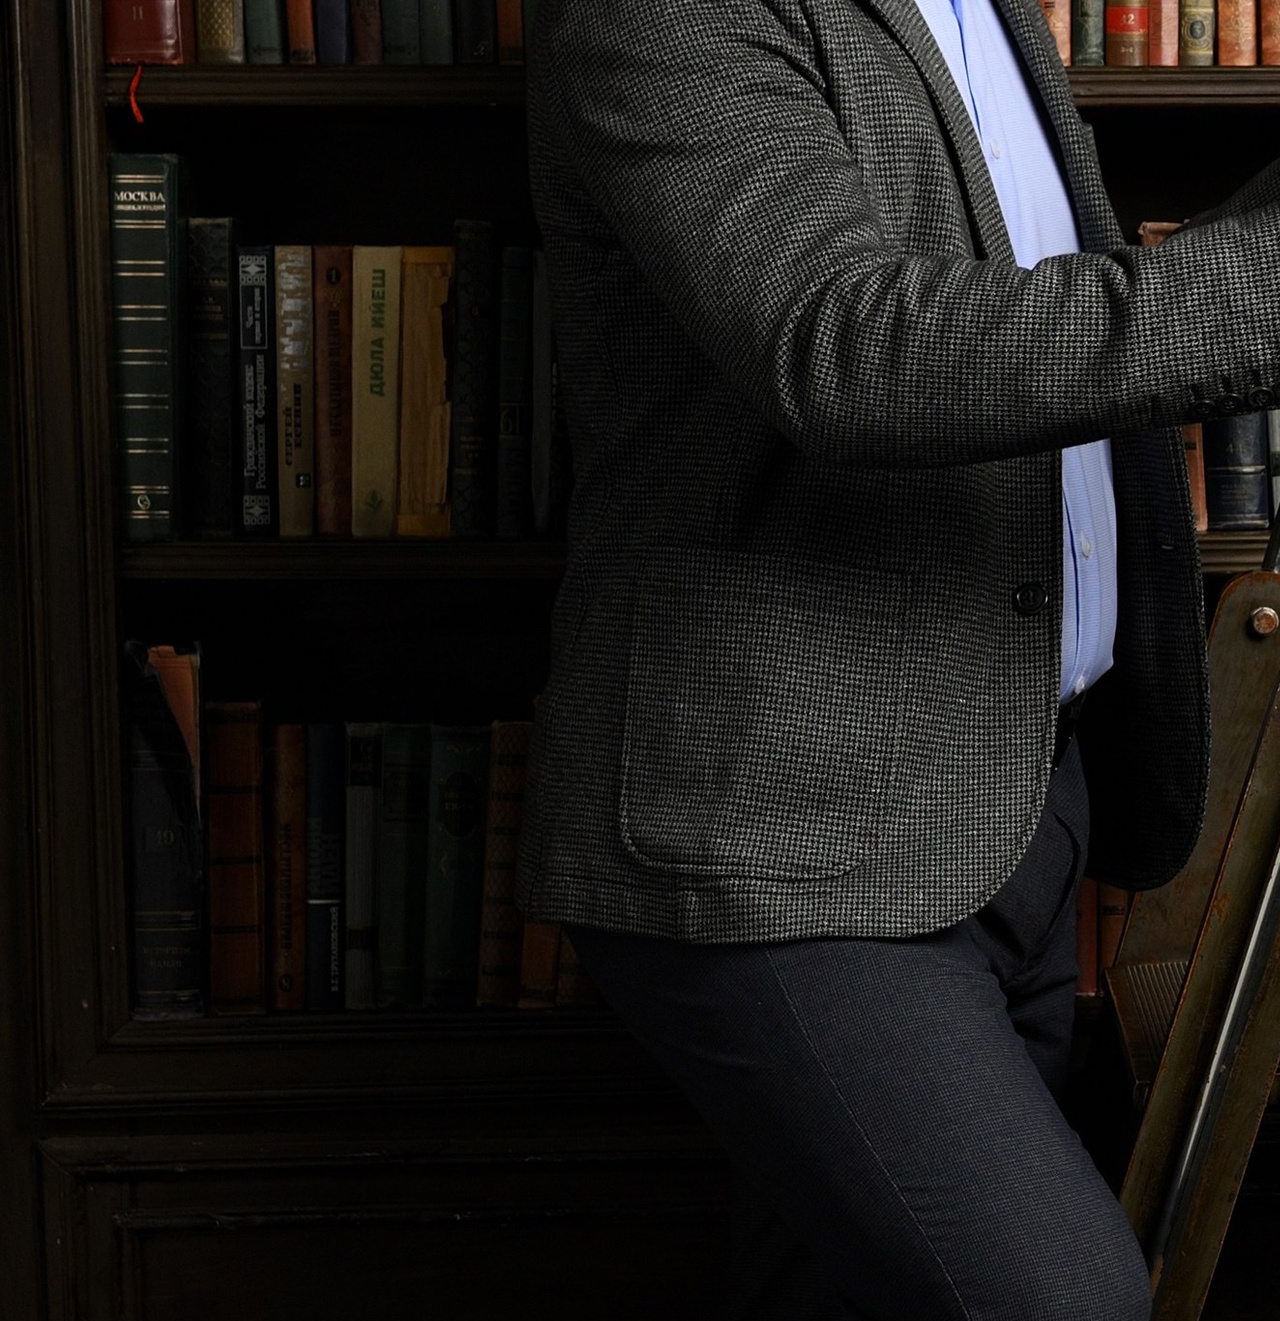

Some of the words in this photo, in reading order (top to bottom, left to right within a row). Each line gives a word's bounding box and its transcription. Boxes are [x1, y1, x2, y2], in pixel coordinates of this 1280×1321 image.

[131, 5, 144, 21] II
[113, 190, 166, 202] МОСКВА
[369, 268, 387, 329] ИЙЕШ
[244, 363, 256, 401] кодекс
[254, 353, 268, 418] Федерации
[369, 334, 387, 398] ДЮЛА
[243, 402, 257, 477] Гражданский
[282, 406, 294, 467] СЕРГЕЙ
[293, 382, 304, 449] ЕСЕНИН
[254, 423, 267, 489] Российской
